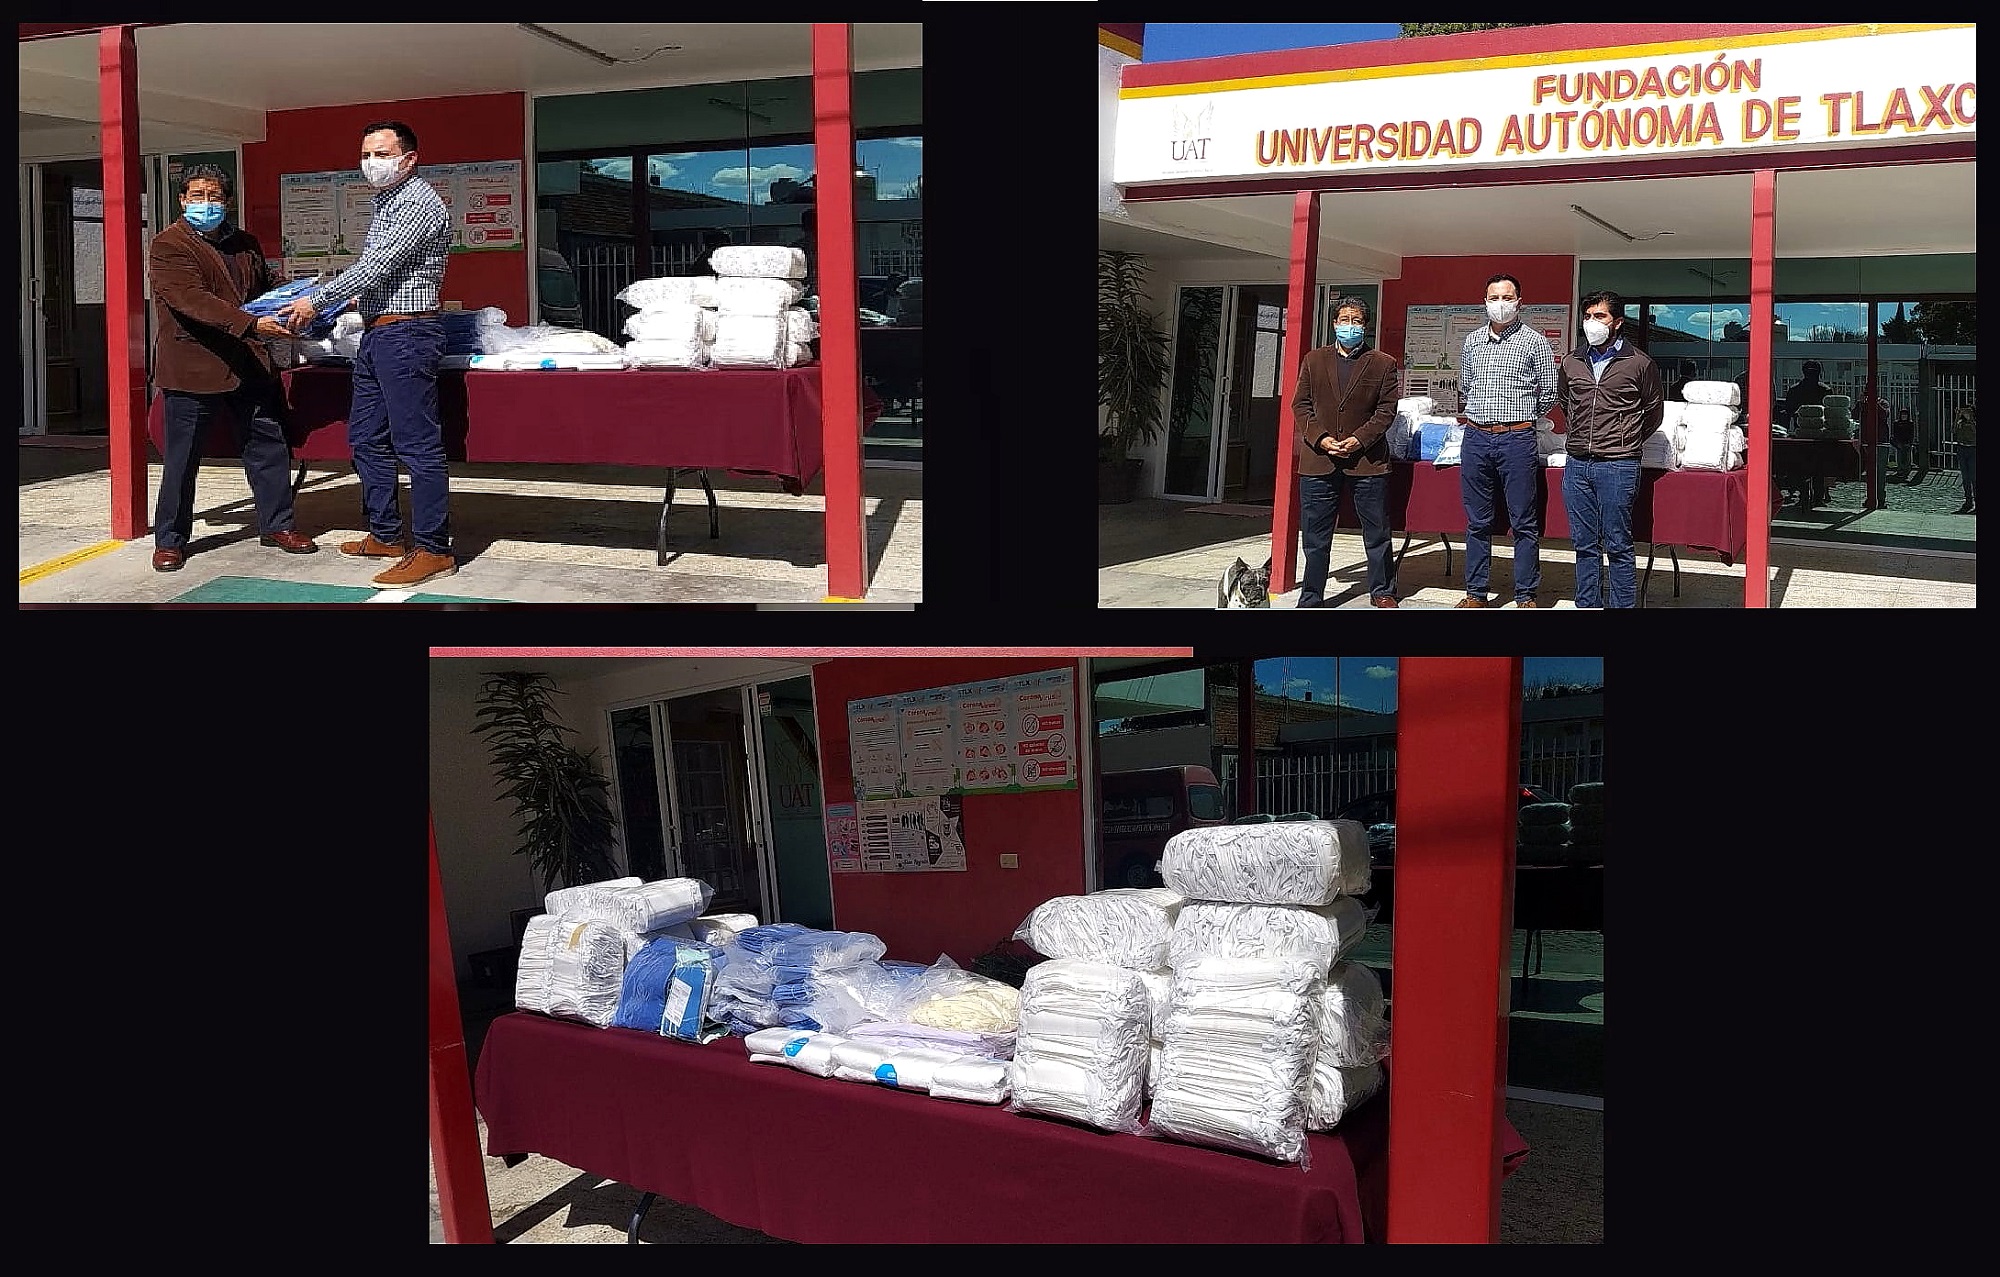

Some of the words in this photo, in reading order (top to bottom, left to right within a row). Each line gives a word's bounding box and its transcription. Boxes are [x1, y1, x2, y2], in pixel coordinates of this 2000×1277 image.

[1533, 52, 1762, 105] FUNDACIÓN
[1171, 138, 1211, 161] UAT
[1256, 117, 1482, 167] UNIVERSIDAD
[1496, 101, 1724, 155] AUTÓNOMA
[1742, 96, 1801, 142] DE
[780, 783, 814, 808] UAT
